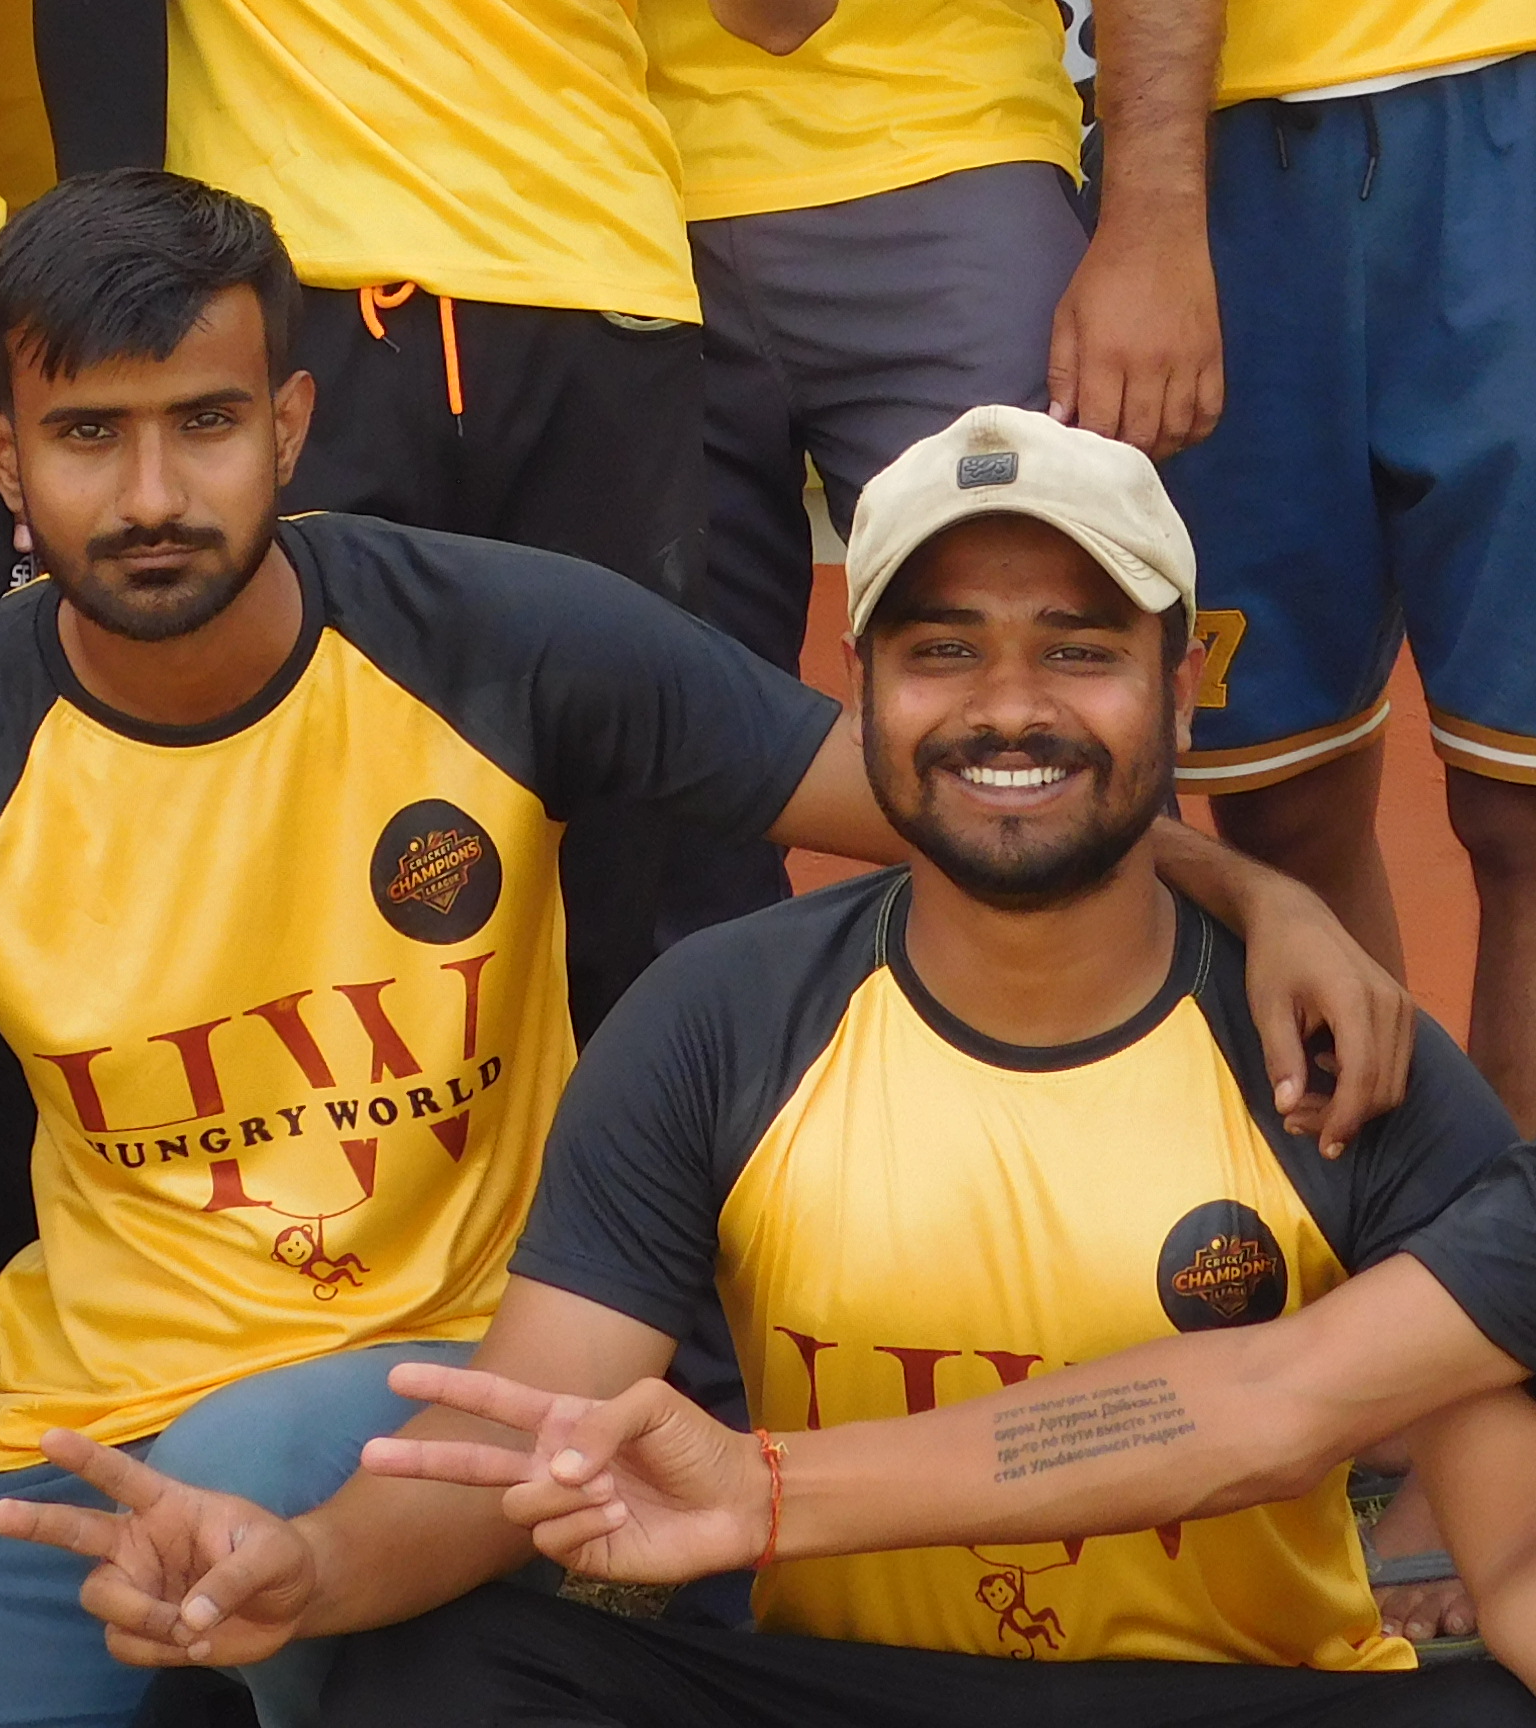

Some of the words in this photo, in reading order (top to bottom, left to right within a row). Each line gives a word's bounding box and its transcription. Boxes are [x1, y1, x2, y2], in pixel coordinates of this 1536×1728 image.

[390, 841, 479, 898] CHAMPIONS
[425, 873, 461, 895] LEAGUE
[33, 951, 496, 1212] HW
[86, 1105, 308, 1169] HUNGRY
[325, 1055, 502, 1131] WORLD
